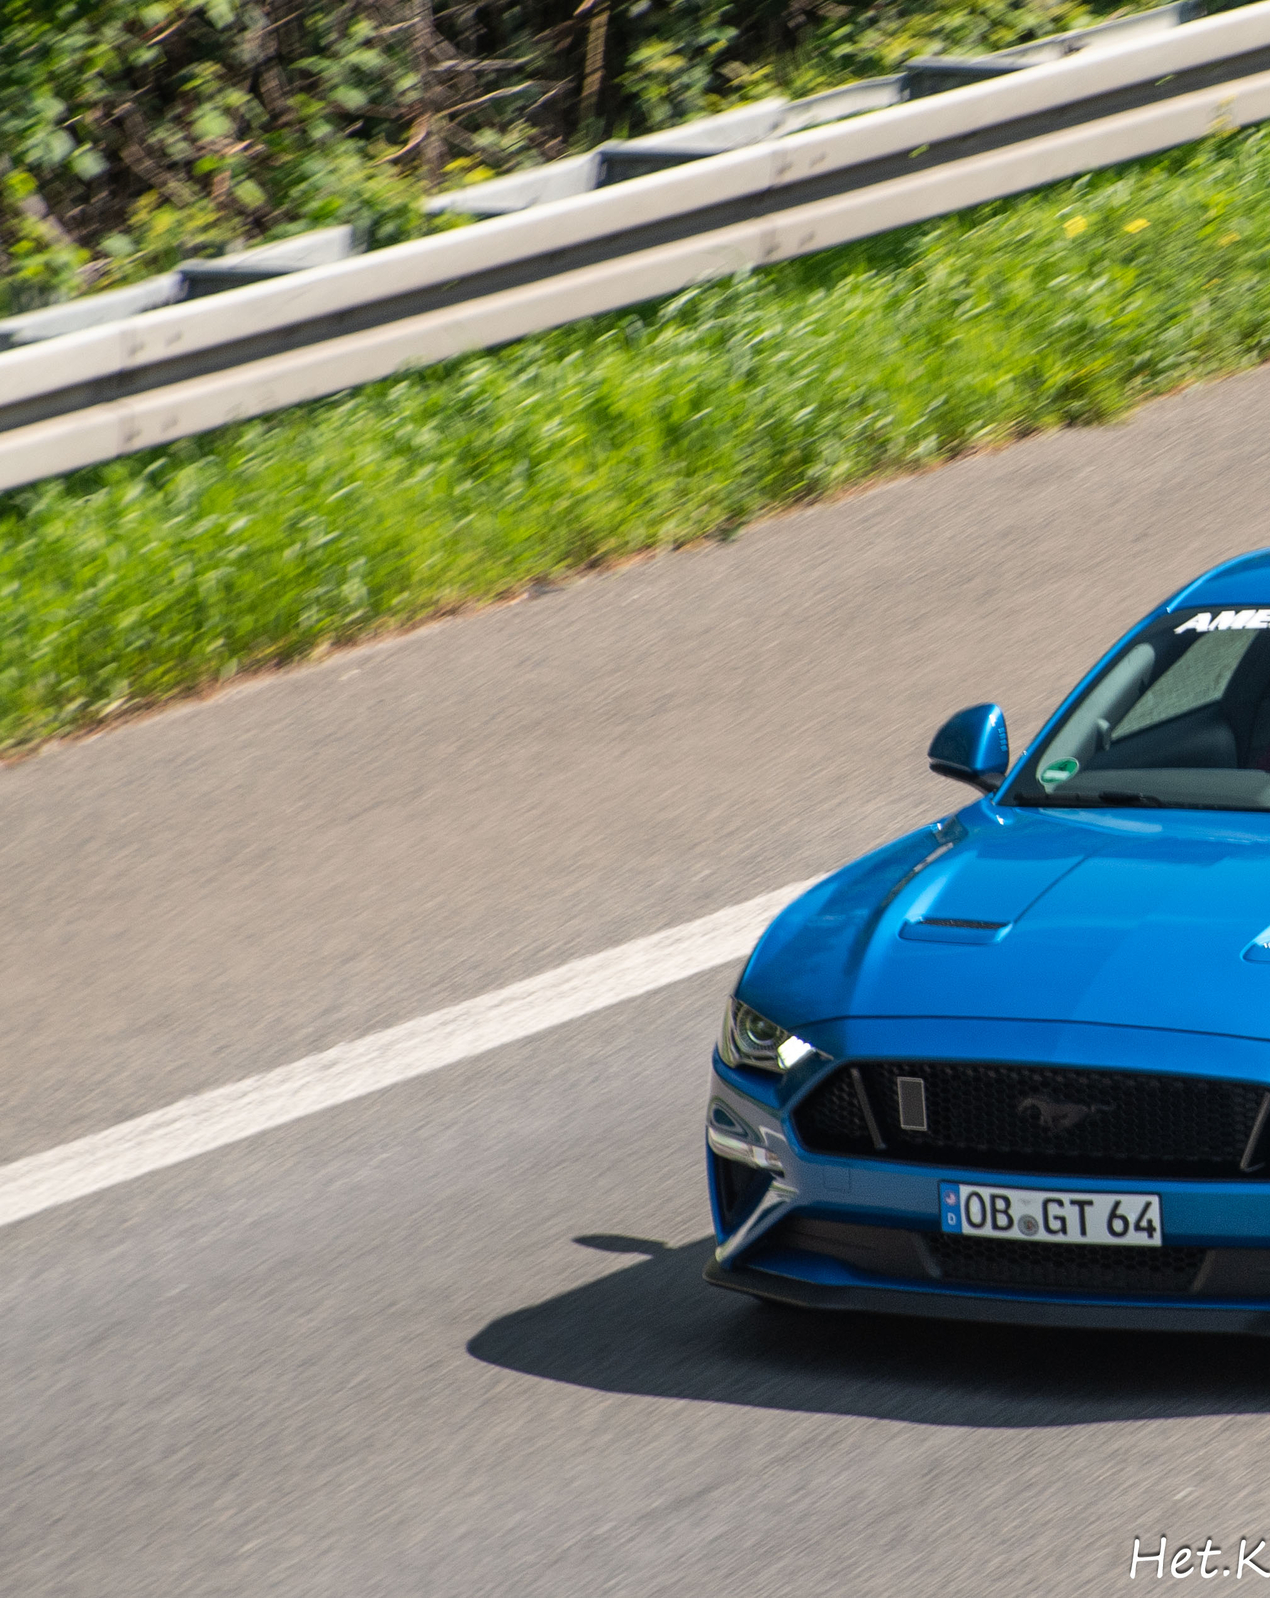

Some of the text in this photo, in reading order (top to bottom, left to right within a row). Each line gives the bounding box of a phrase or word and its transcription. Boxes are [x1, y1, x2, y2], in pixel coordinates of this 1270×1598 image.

[946, 1211, 957, 1226] D
[964, 1190, 1014, 1231] OB
[1042, 1197, 1094, 1237] GT
[1106, 1200, 1157, 1240] 64
